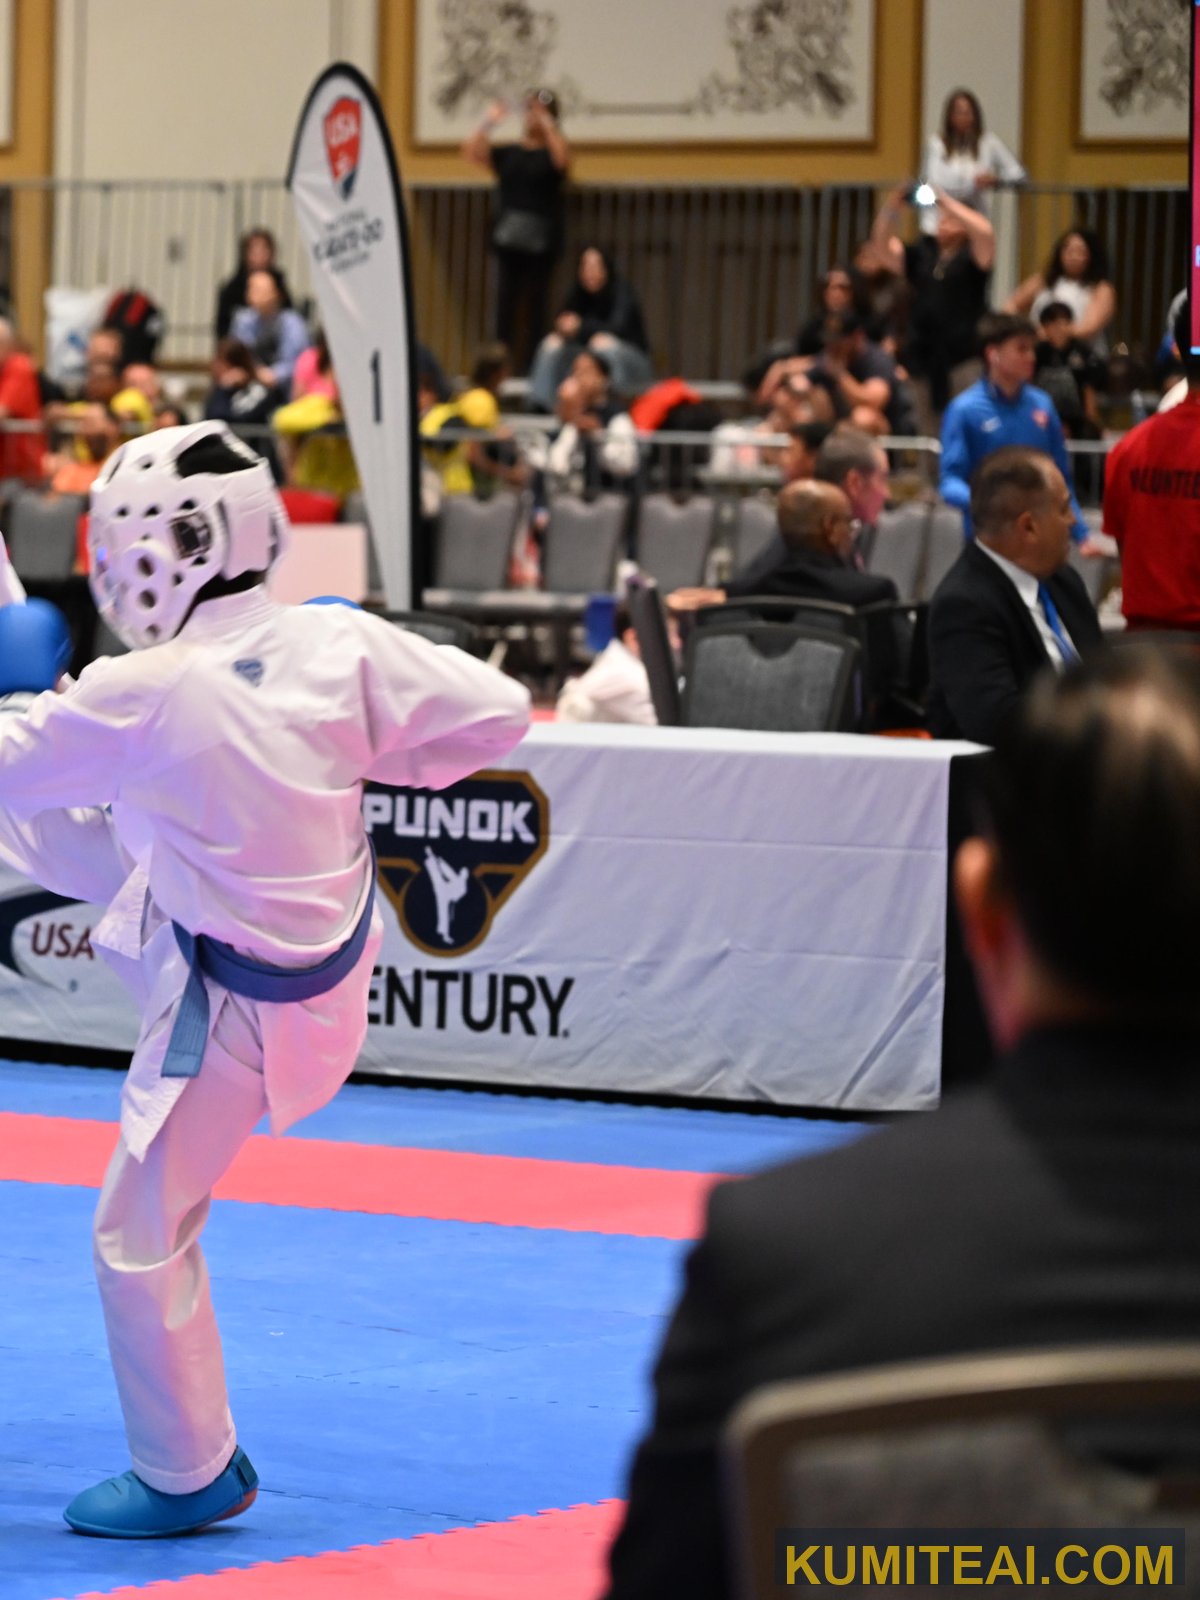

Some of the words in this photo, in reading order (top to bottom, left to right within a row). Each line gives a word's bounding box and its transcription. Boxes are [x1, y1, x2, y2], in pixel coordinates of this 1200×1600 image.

[369, 350, 383, 425] 1
[363, 793, 536, 844] PUNOK
[31, 921, 95, 961] USA
